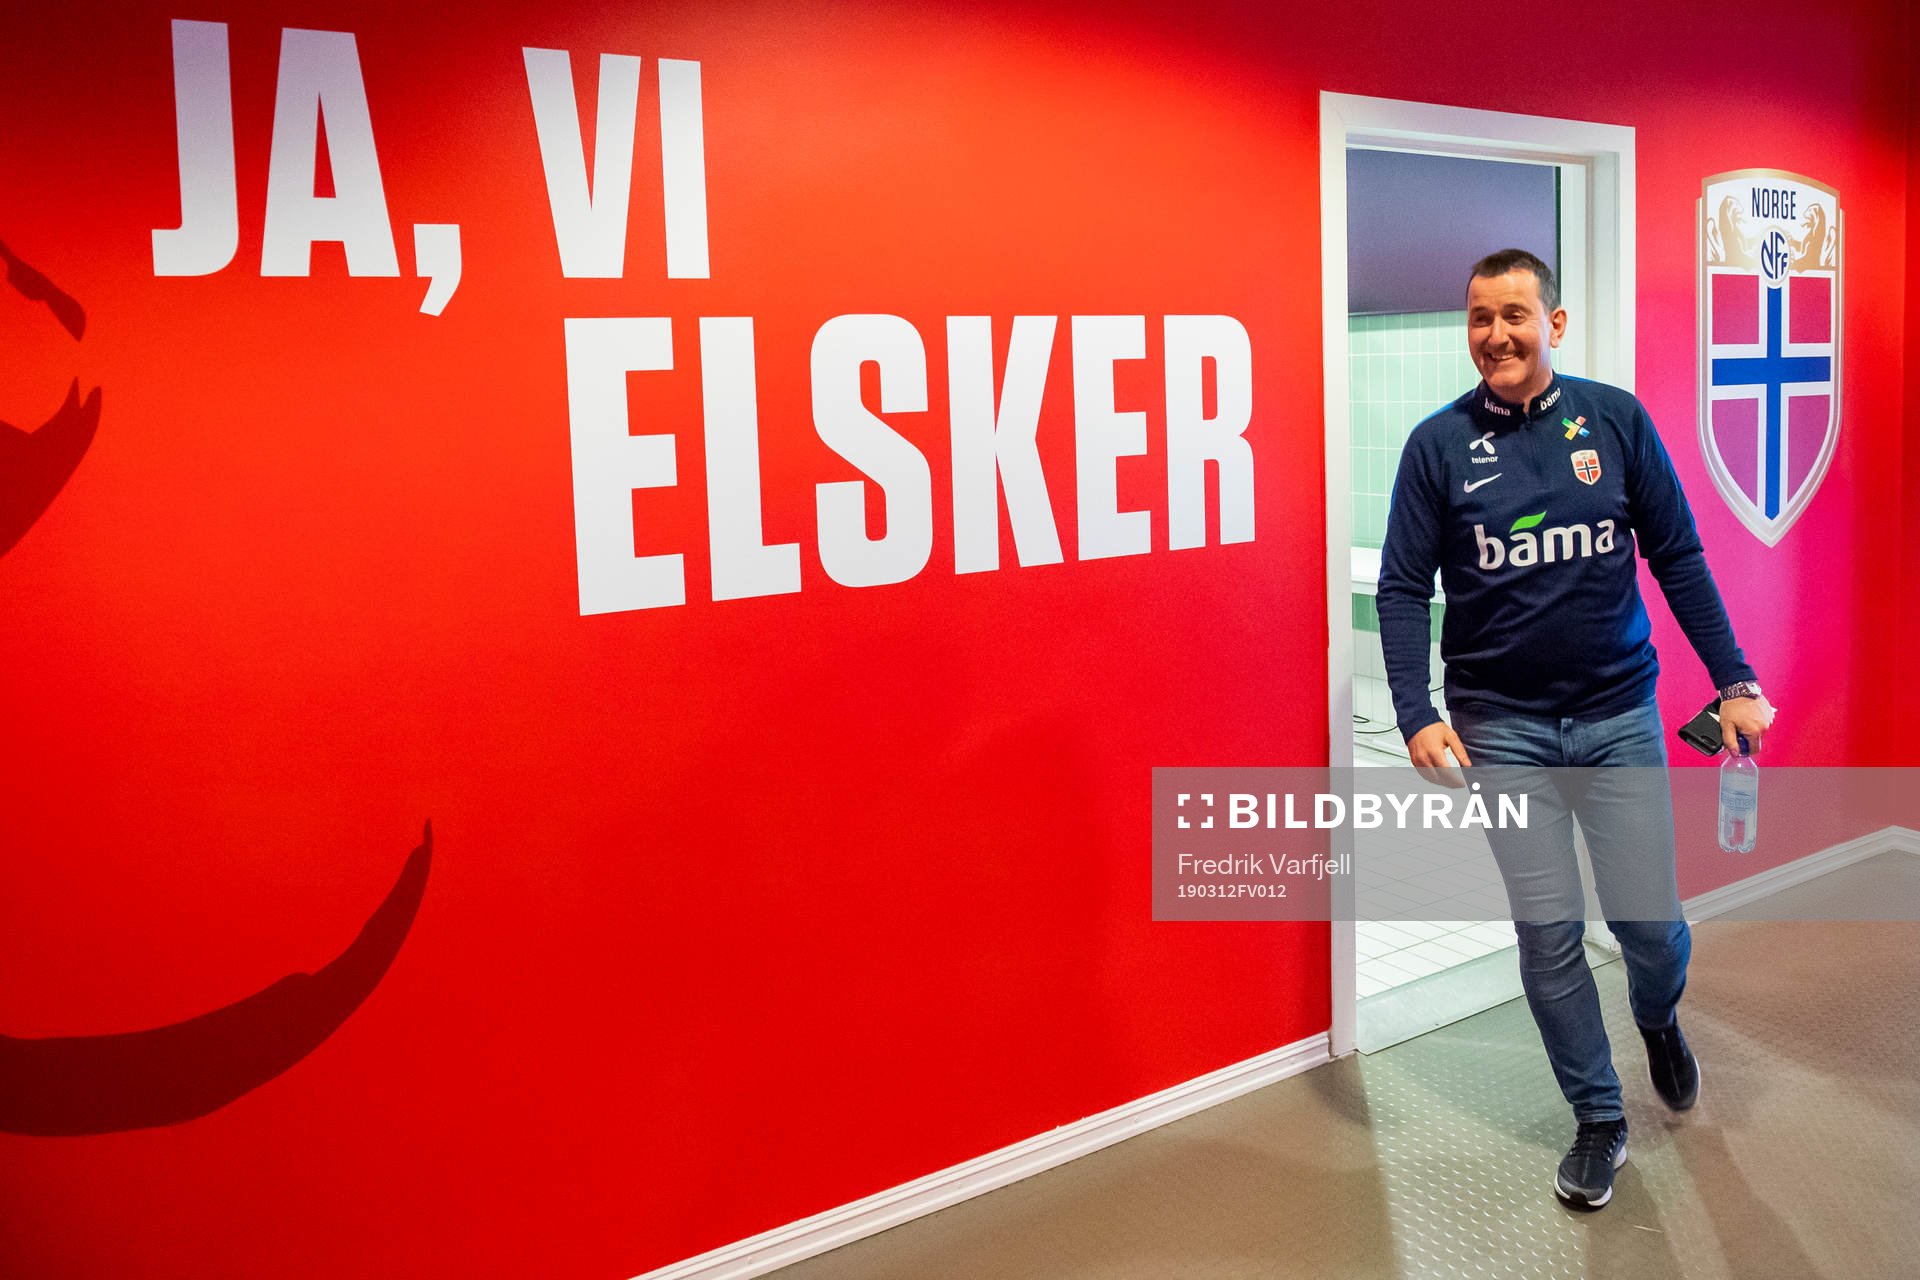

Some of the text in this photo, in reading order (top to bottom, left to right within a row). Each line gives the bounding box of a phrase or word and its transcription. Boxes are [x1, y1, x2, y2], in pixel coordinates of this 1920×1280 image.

[151, 18, 710, 317] JA, VI
[1751, 187, 1797, 220] NORGE
[564, 313, 1255, 616] ELSKER
[1471, 456, 1498, 464] telenor
[1473, 519, 1615, 570] bama
